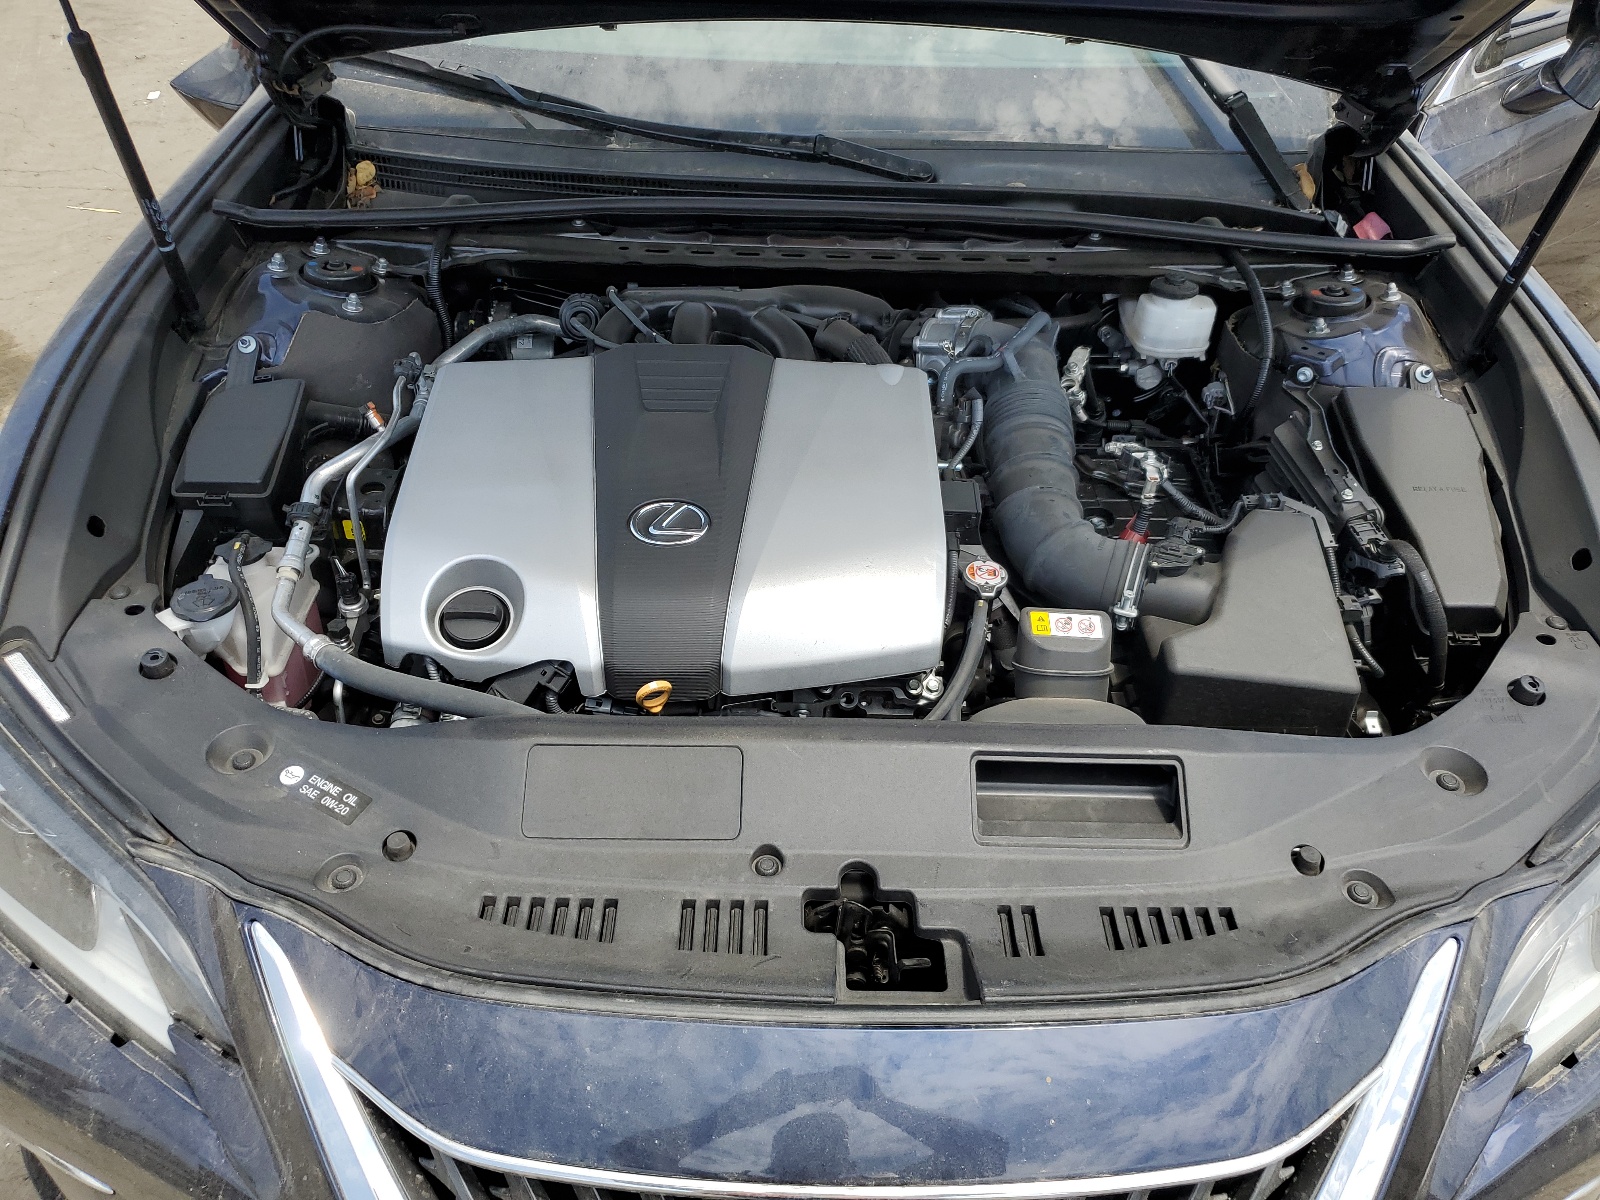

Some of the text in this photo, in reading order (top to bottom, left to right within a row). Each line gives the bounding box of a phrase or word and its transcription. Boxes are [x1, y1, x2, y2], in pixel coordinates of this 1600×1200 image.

[299, 784, 350, 815] SAE 0W-20
[308, 775, 359, 807] ENGINE OIL
